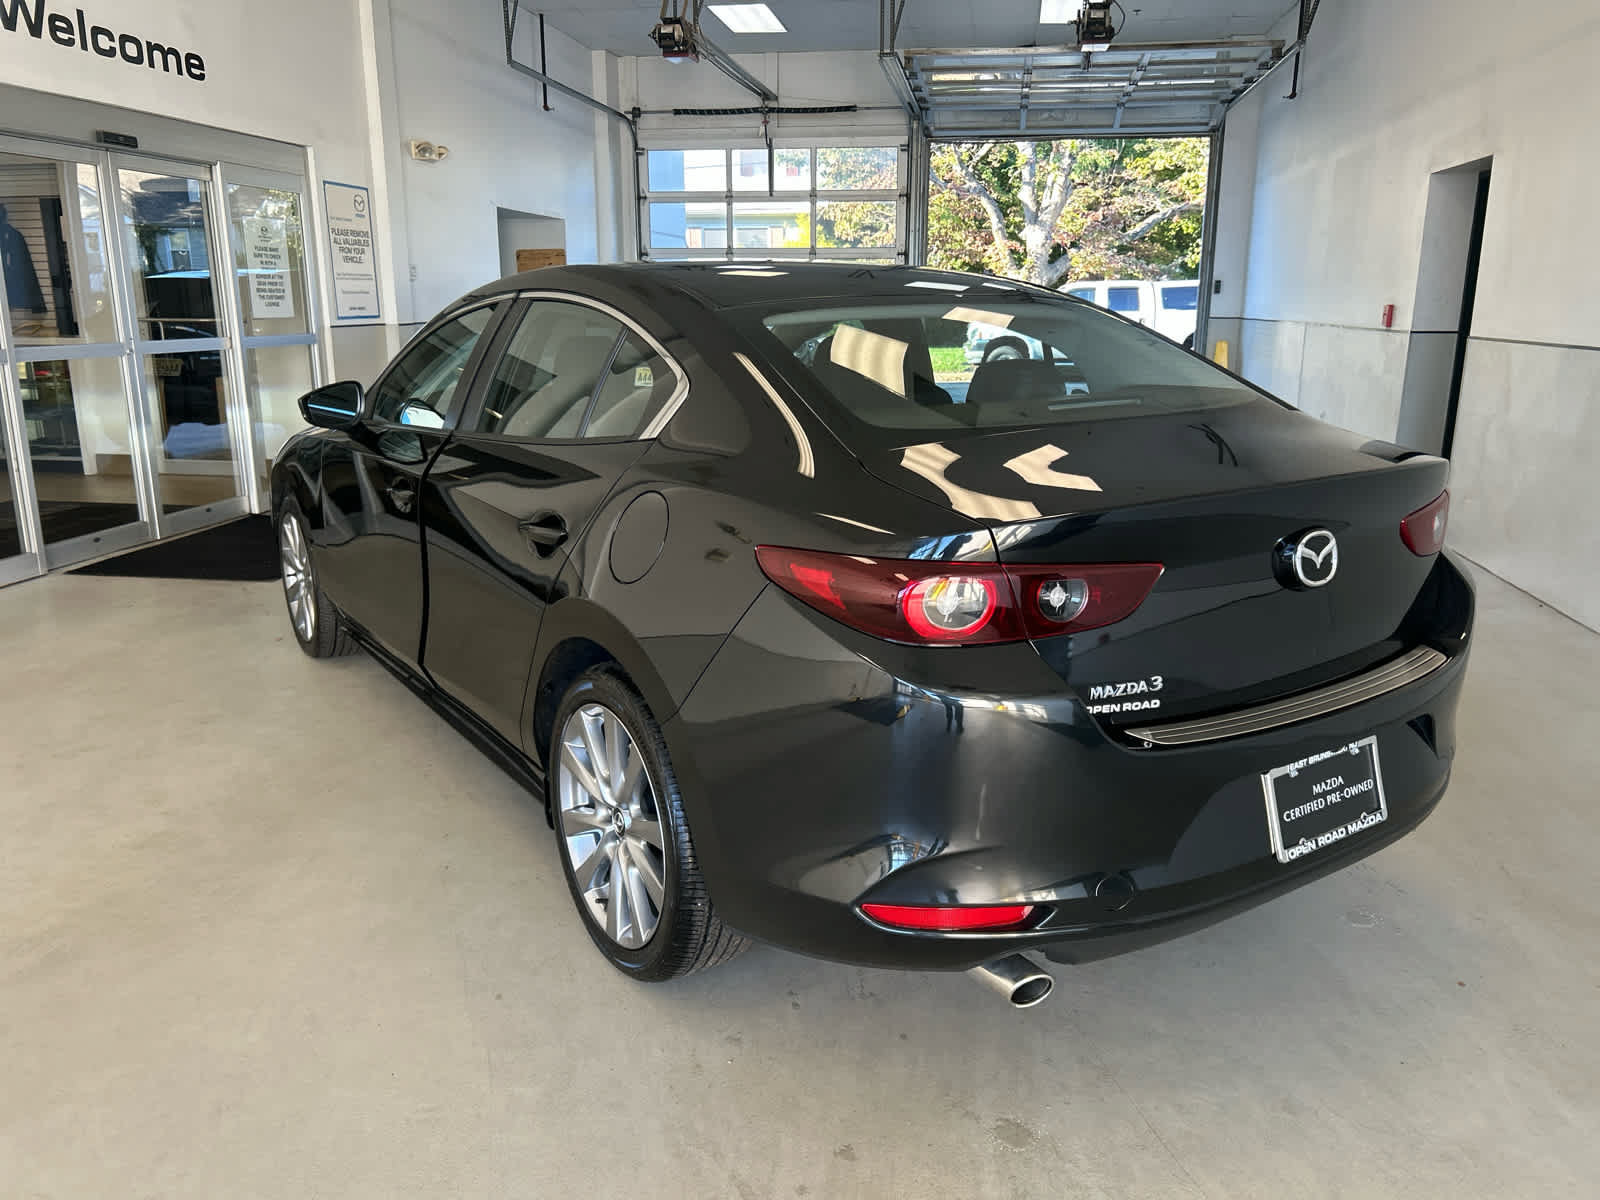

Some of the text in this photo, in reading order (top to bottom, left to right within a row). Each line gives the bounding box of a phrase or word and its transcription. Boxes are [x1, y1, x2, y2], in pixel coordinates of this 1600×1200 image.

[0, 0, 205, 81] Welcome
[331, 228, 349, 237] PLEASE
[339, 246, 352, 254] FROM
[1122, 699, 1161, 712] ROAD
[1289, 758, 1308, 771] EAST
[1312, 775, 1344, 795] MAZDA
[1283, 778, 1374, 822] CERTIFIED PRE-OWNED
[1288, 813, 1384, 860] OPEN ROAD MAZDA
